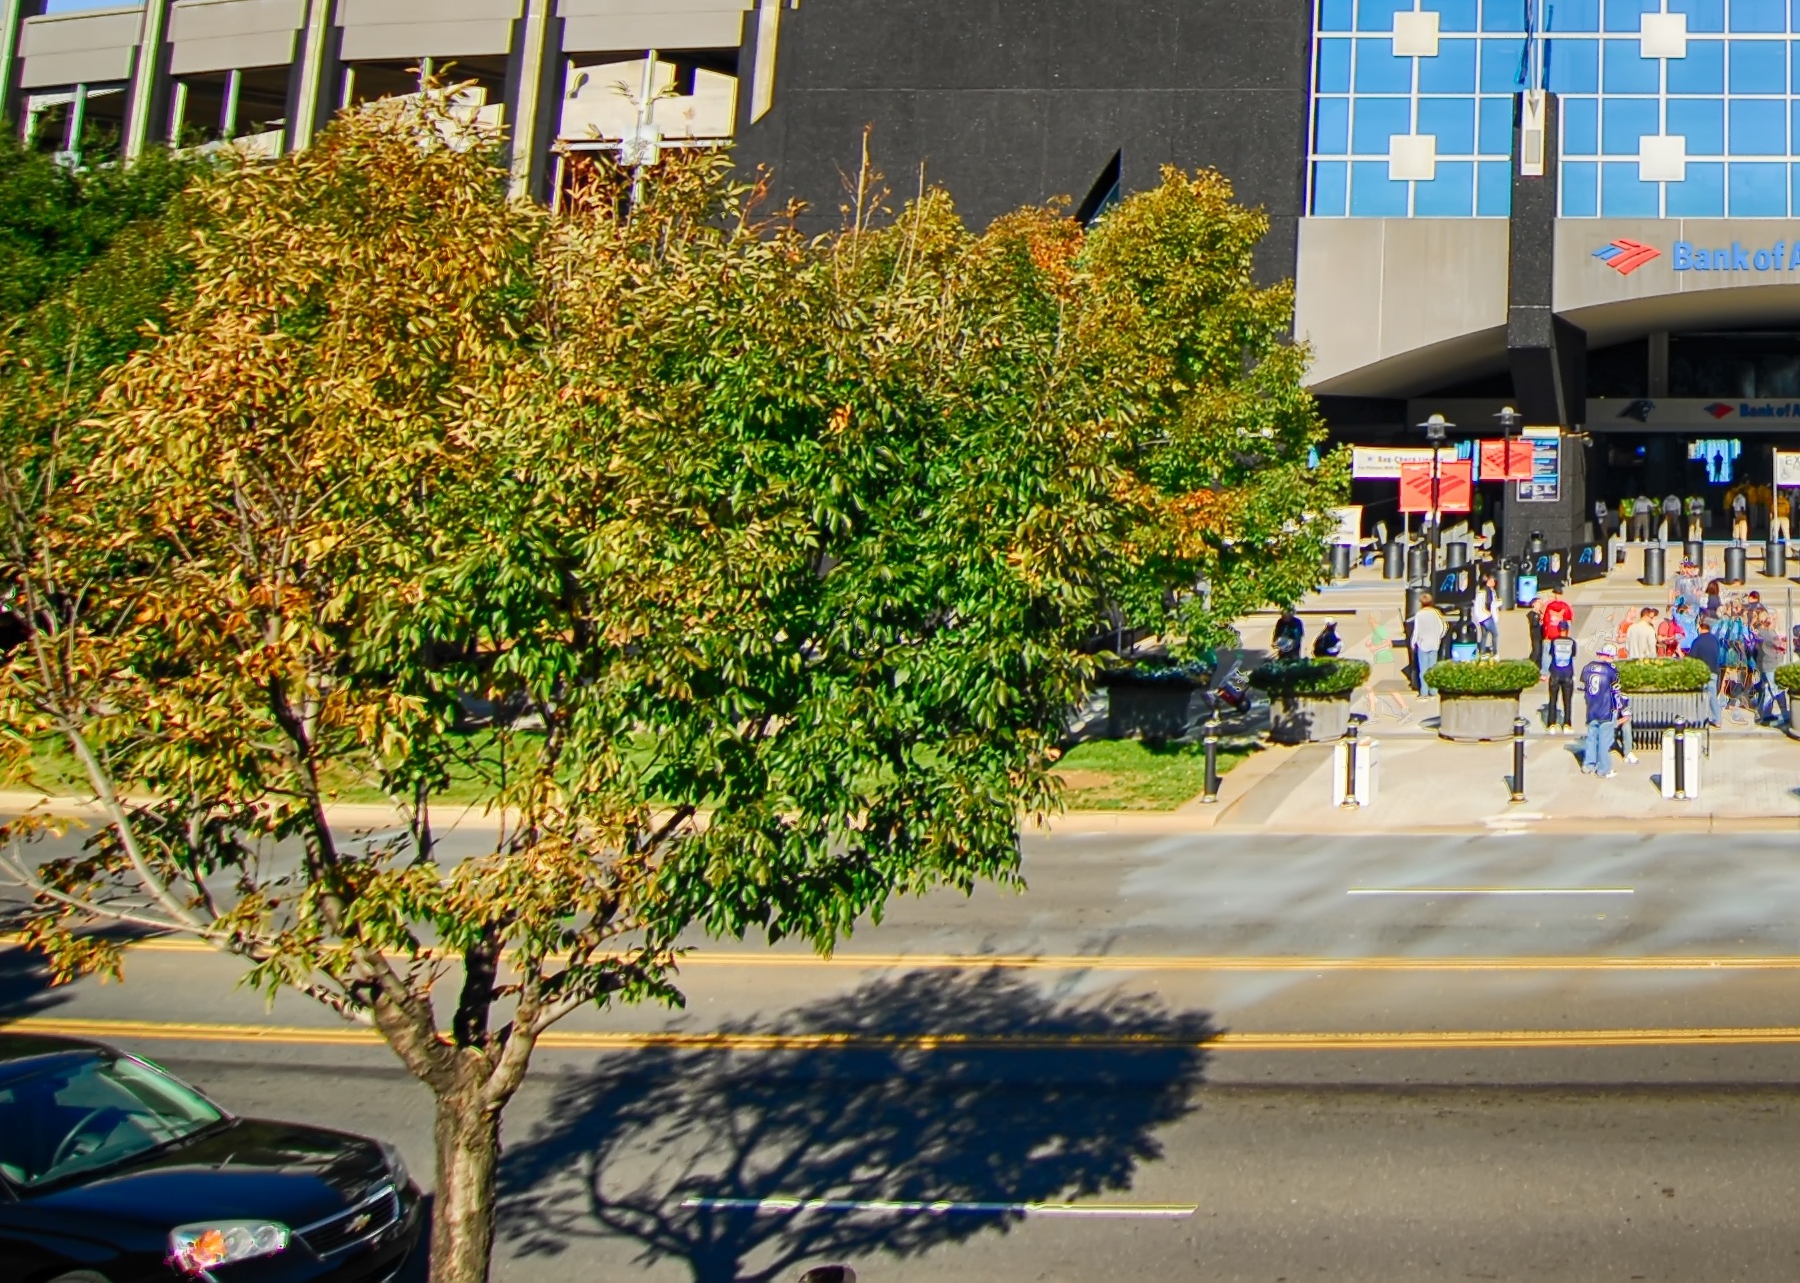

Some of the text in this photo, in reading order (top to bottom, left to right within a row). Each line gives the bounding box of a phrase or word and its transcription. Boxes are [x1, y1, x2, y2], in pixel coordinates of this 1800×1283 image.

[1672, 241, 1750, 271] Bank
[1753, 241, 1785, 271] of
[1739, 403, 1775, 417] Bank
[1776, 403, 1791, 417] of
